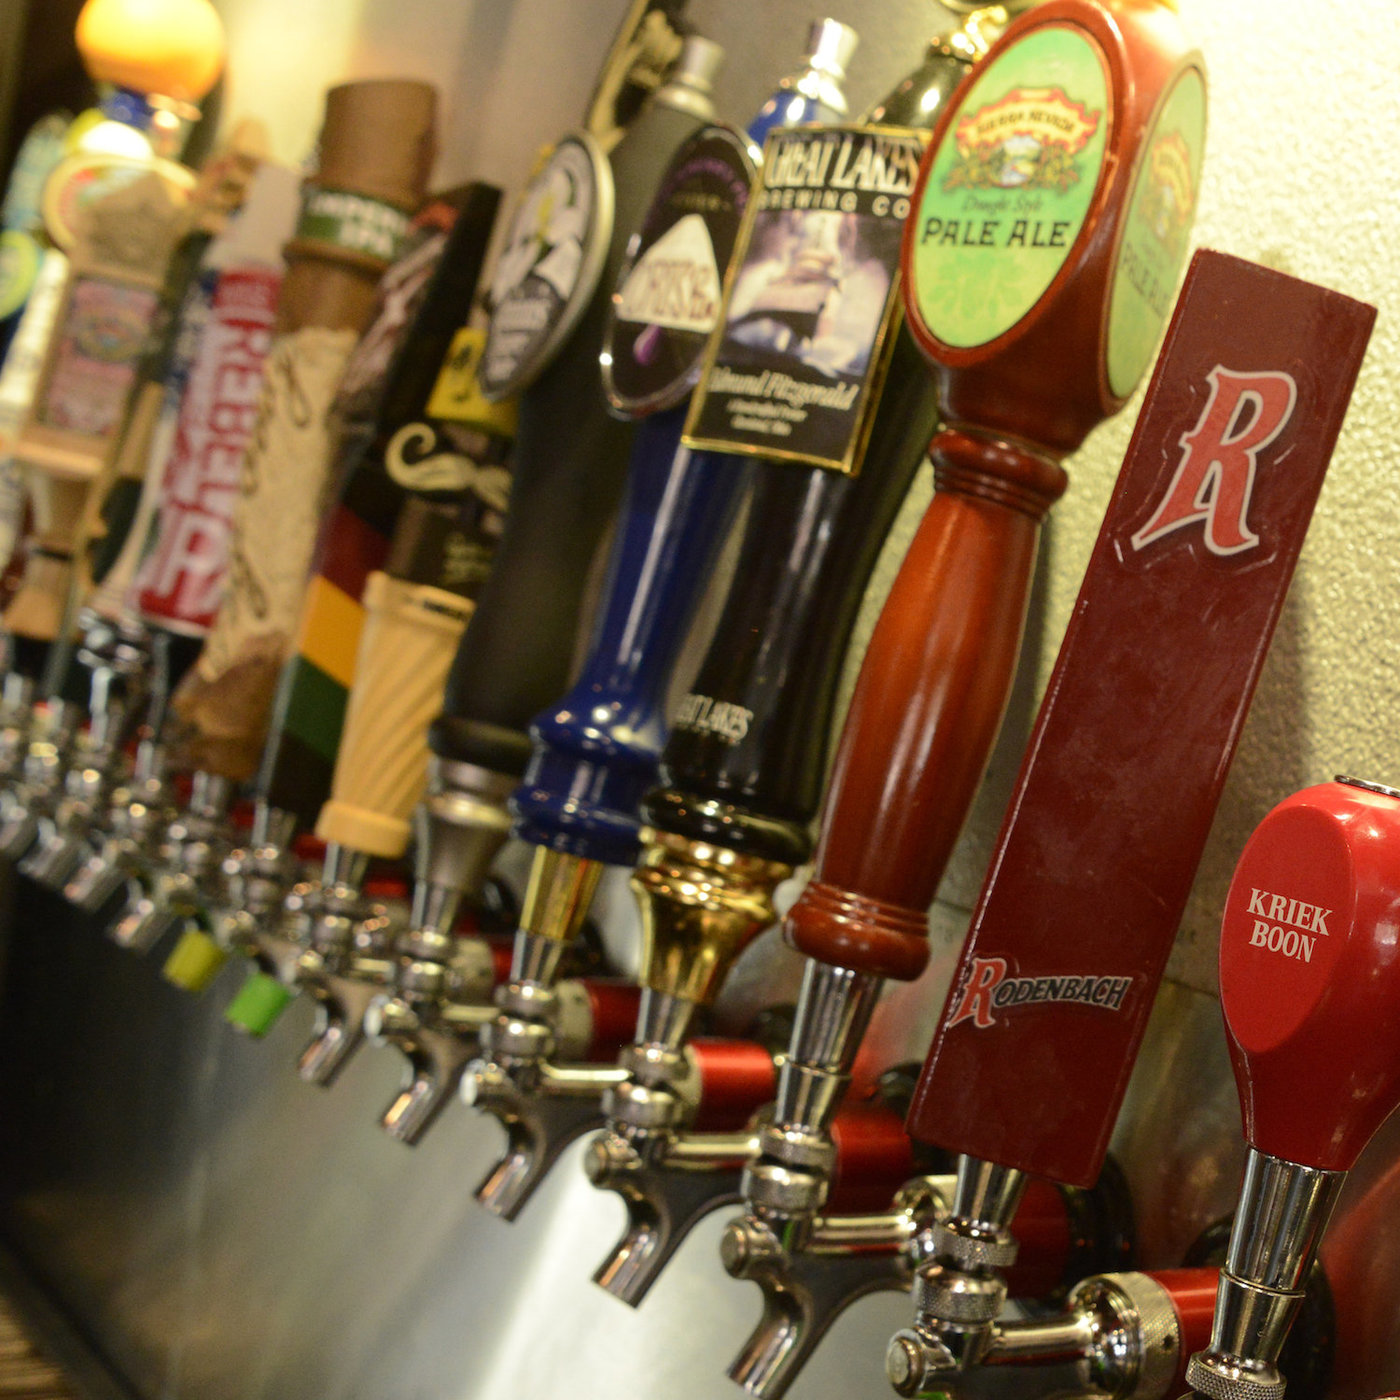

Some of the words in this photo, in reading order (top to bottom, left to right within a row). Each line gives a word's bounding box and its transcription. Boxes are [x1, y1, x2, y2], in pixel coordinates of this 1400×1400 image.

[920, 217, 1000, 247] PALE
[1006, 219, 1071, 247] ALE
[1131, 364, 1297, 557] R
[1246, 887, 1333, 937] KRIEK
[1248, 919, 1317, 963] BOON
[949, 957, 1133, 1029] RODENBACH
